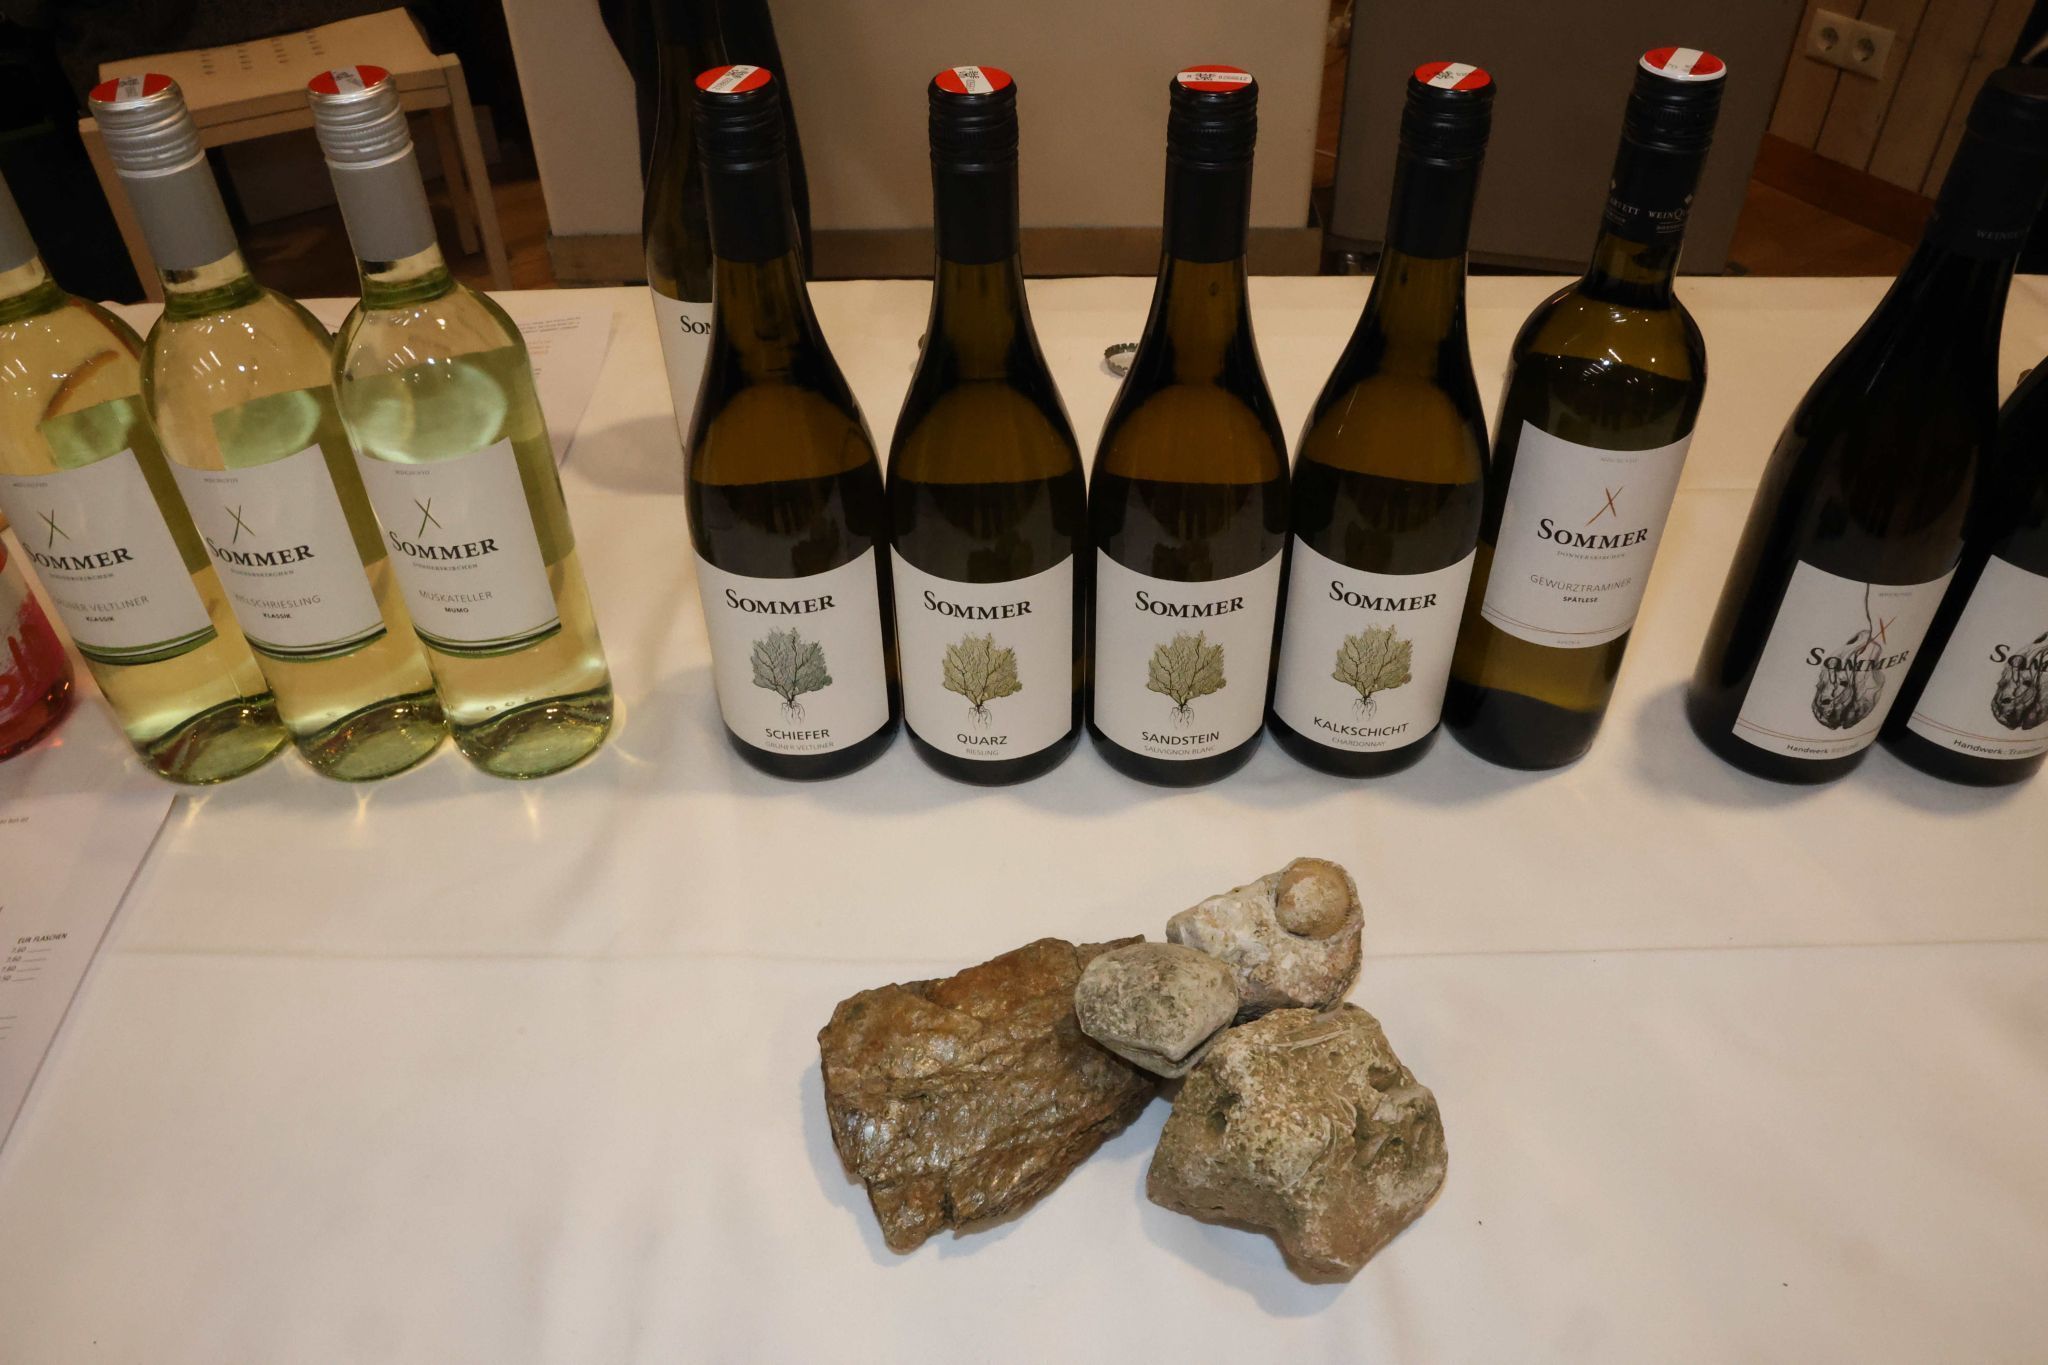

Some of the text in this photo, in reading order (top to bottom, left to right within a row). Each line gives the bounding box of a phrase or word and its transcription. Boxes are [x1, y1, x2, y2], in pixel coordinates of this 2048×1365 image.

[389, 530, 499, 560] SOMMER
[1537, 519, 1649, 549] SOMMER
[22, 542, 134, 571] SOMMER
[206, 537, 315, 566] SOMMER
[419, 589, 493, 603] MUSKATELLER
[725, 588, 835, 614] SOMMER
[923, 590, 1032, 620] SOMMER
[1135, 591, 1244, 618] SOMMER
[1328, 580, 1437, 612] SOMMER
[1806, 648, 1909, 673] SOMMER
[765, 728, 830, 741] SCHIEFER
[1142, 731, 1220, 745] SANDSTEIN
[1314, 716, 1409, 737] KALKSCHICHT
[957, 733, 1008, 746] QUARZ
[1144, 745, 1191, 755] SAUVIGNON
[1332, 737, 1386, 748] CHARDONNAY
